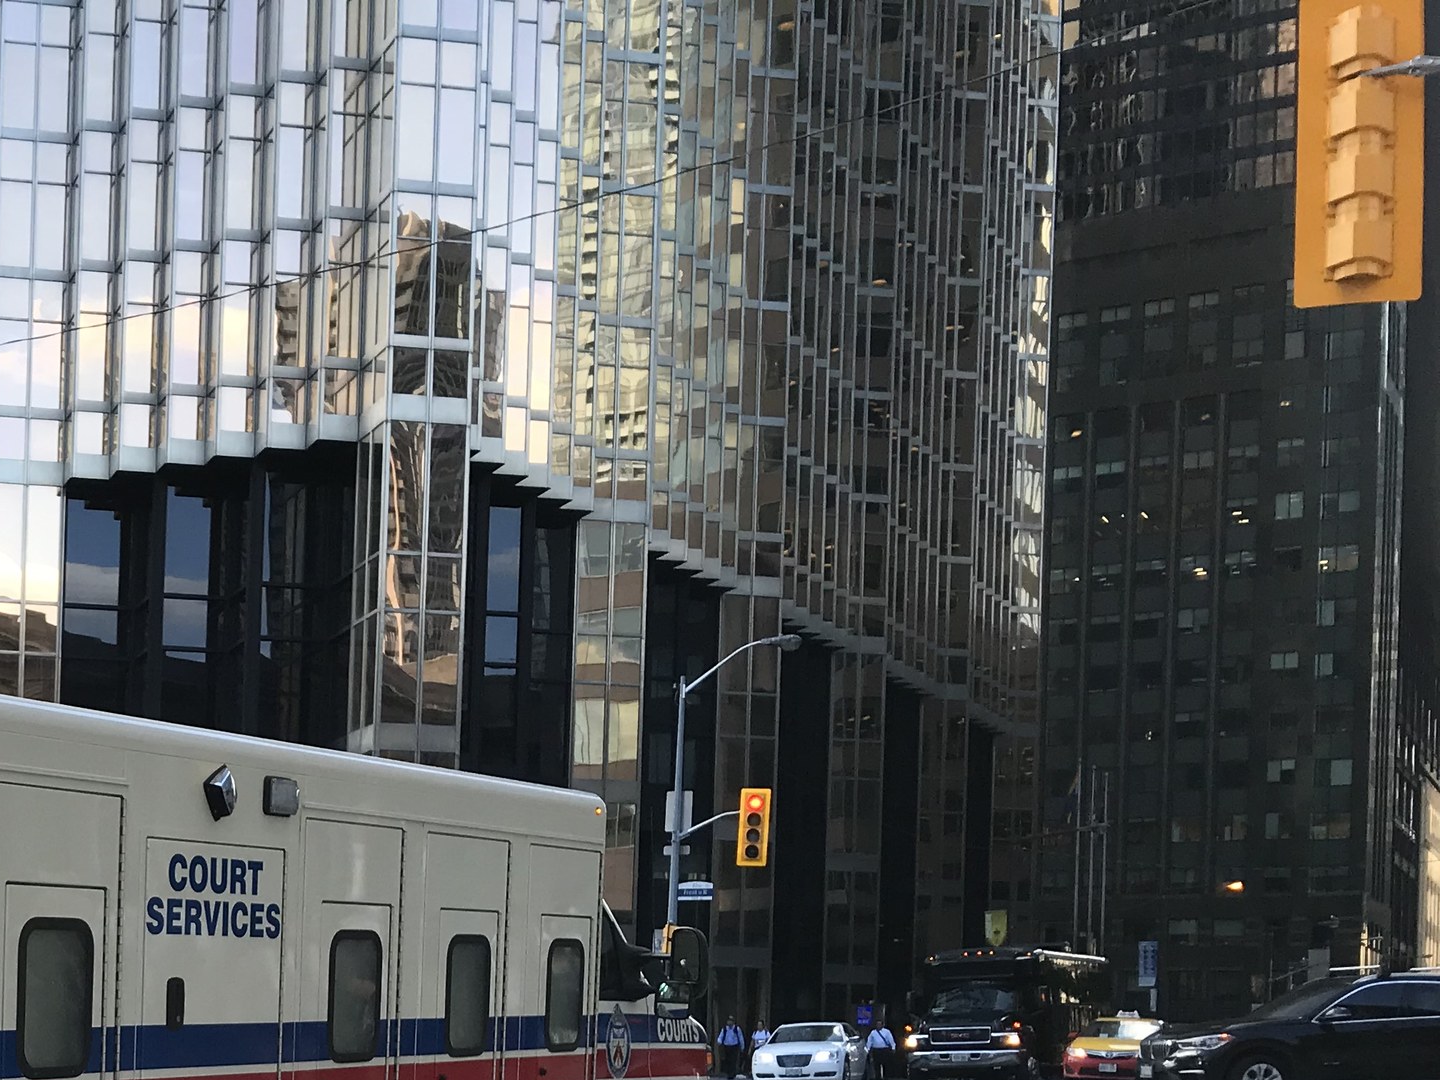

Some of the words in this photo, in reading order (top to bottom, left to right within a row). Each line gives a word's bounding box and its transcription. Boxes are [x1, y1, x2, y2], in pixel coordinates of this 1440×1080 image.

[168, 853, 263, 895] COURT
[146, 896, 281, 939] SERVICES
[657, 1018, 700, 1042] COURTS
